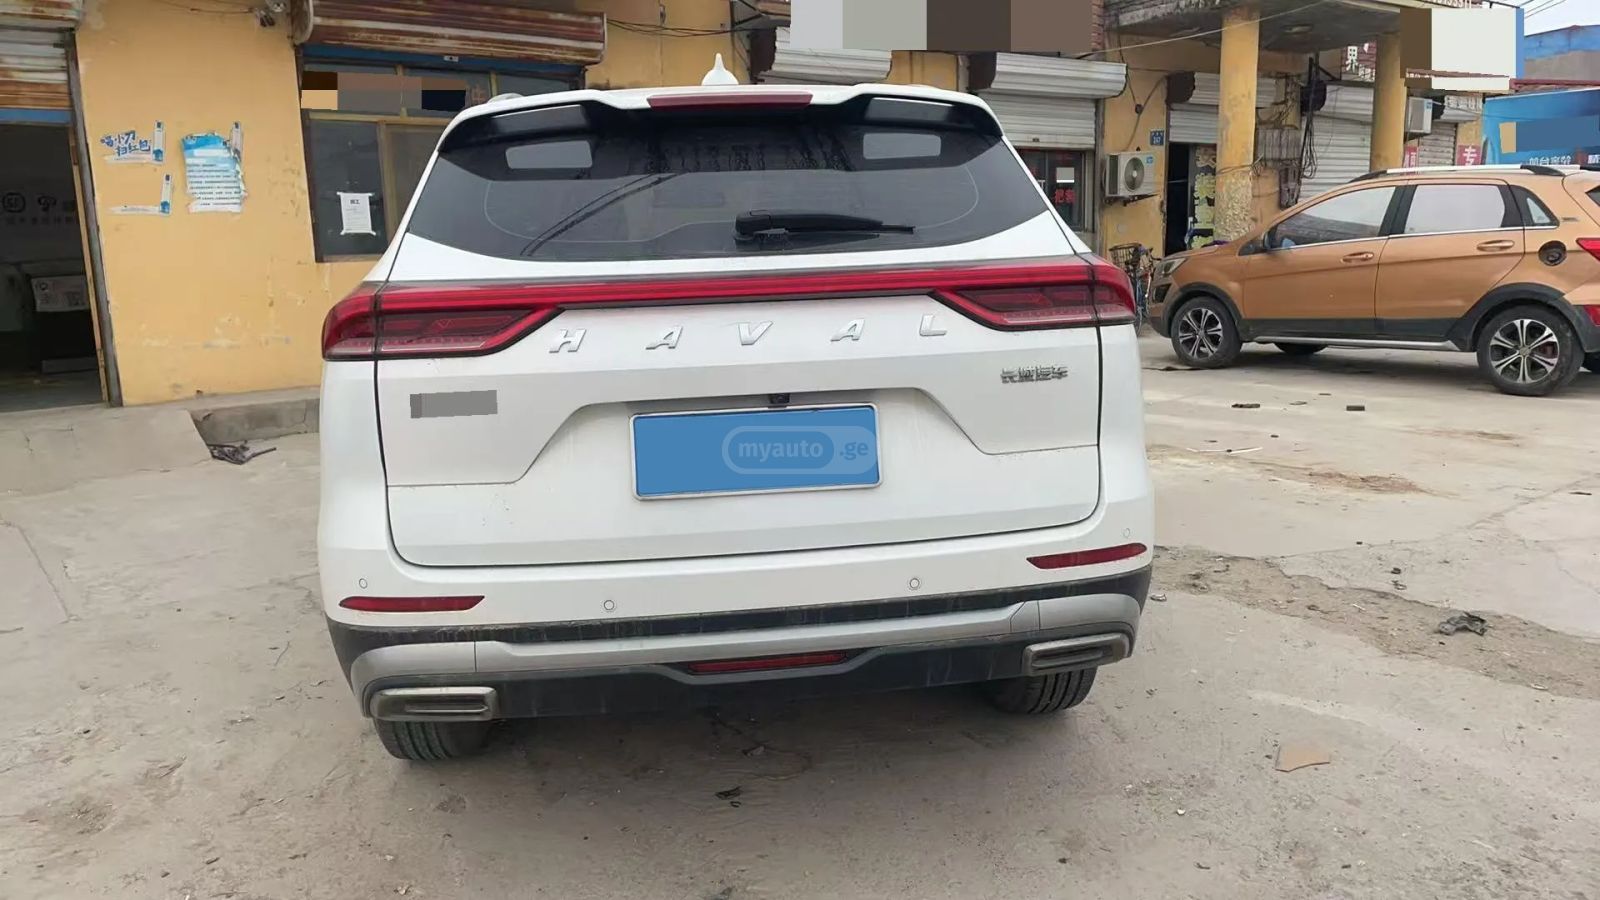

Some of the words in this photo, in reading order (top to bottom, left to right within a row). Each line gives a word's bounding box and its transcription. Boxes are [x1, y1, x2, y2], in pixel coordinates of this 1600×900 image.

[1345, 45, 1359, 73] 界
[116, 140, 151, 156] 扫红包
[549, 314, 948, 354] HAVAL
